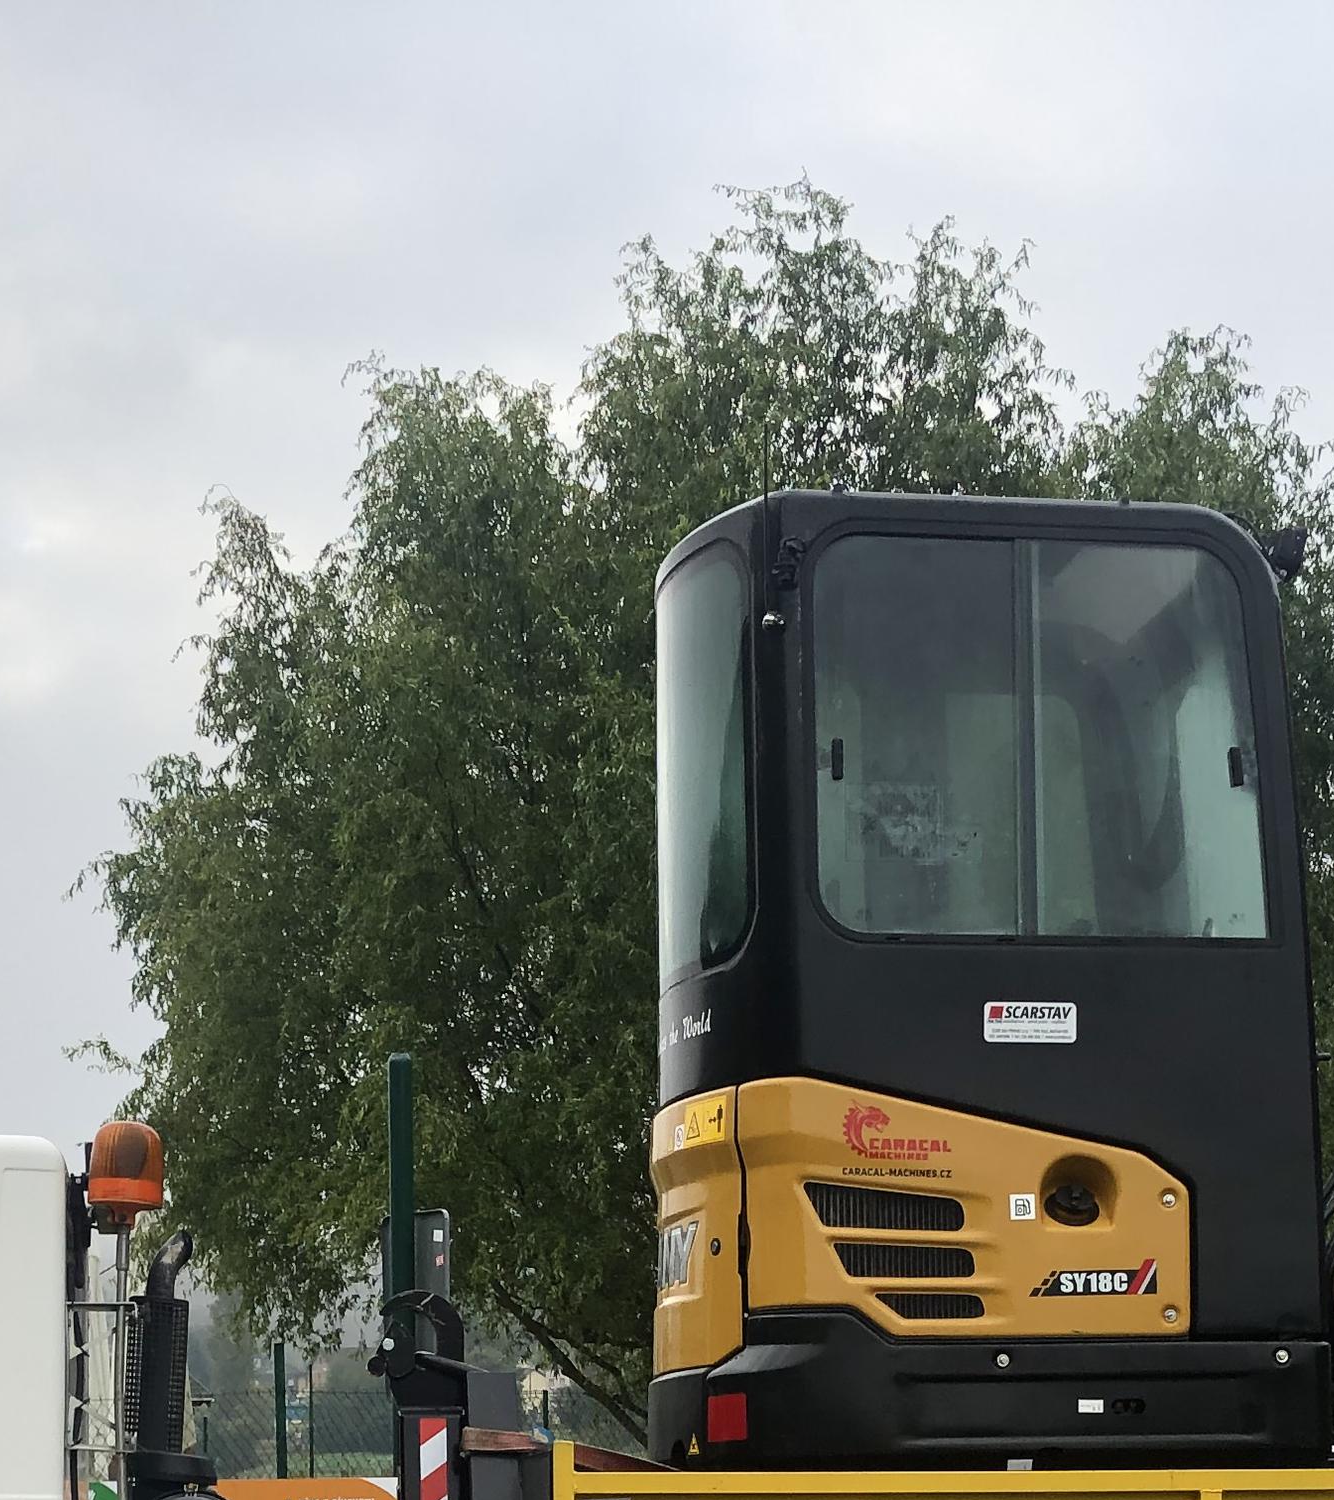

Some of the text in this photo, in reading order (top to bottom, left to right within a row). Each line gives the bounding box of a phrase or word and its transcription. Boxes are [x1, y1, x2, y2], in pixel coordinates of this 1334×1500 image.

[1004, 1006, 1072, 1019] SCARSTAV
[868, 1138, 952, 1153] CARACAL
[868, 1152, 929, 1160] MACHINES
[842, 1167, 952, 1178] CARACAL-MACHINES.CZ
[1059, 1272, 1128, 1293] SY18C
